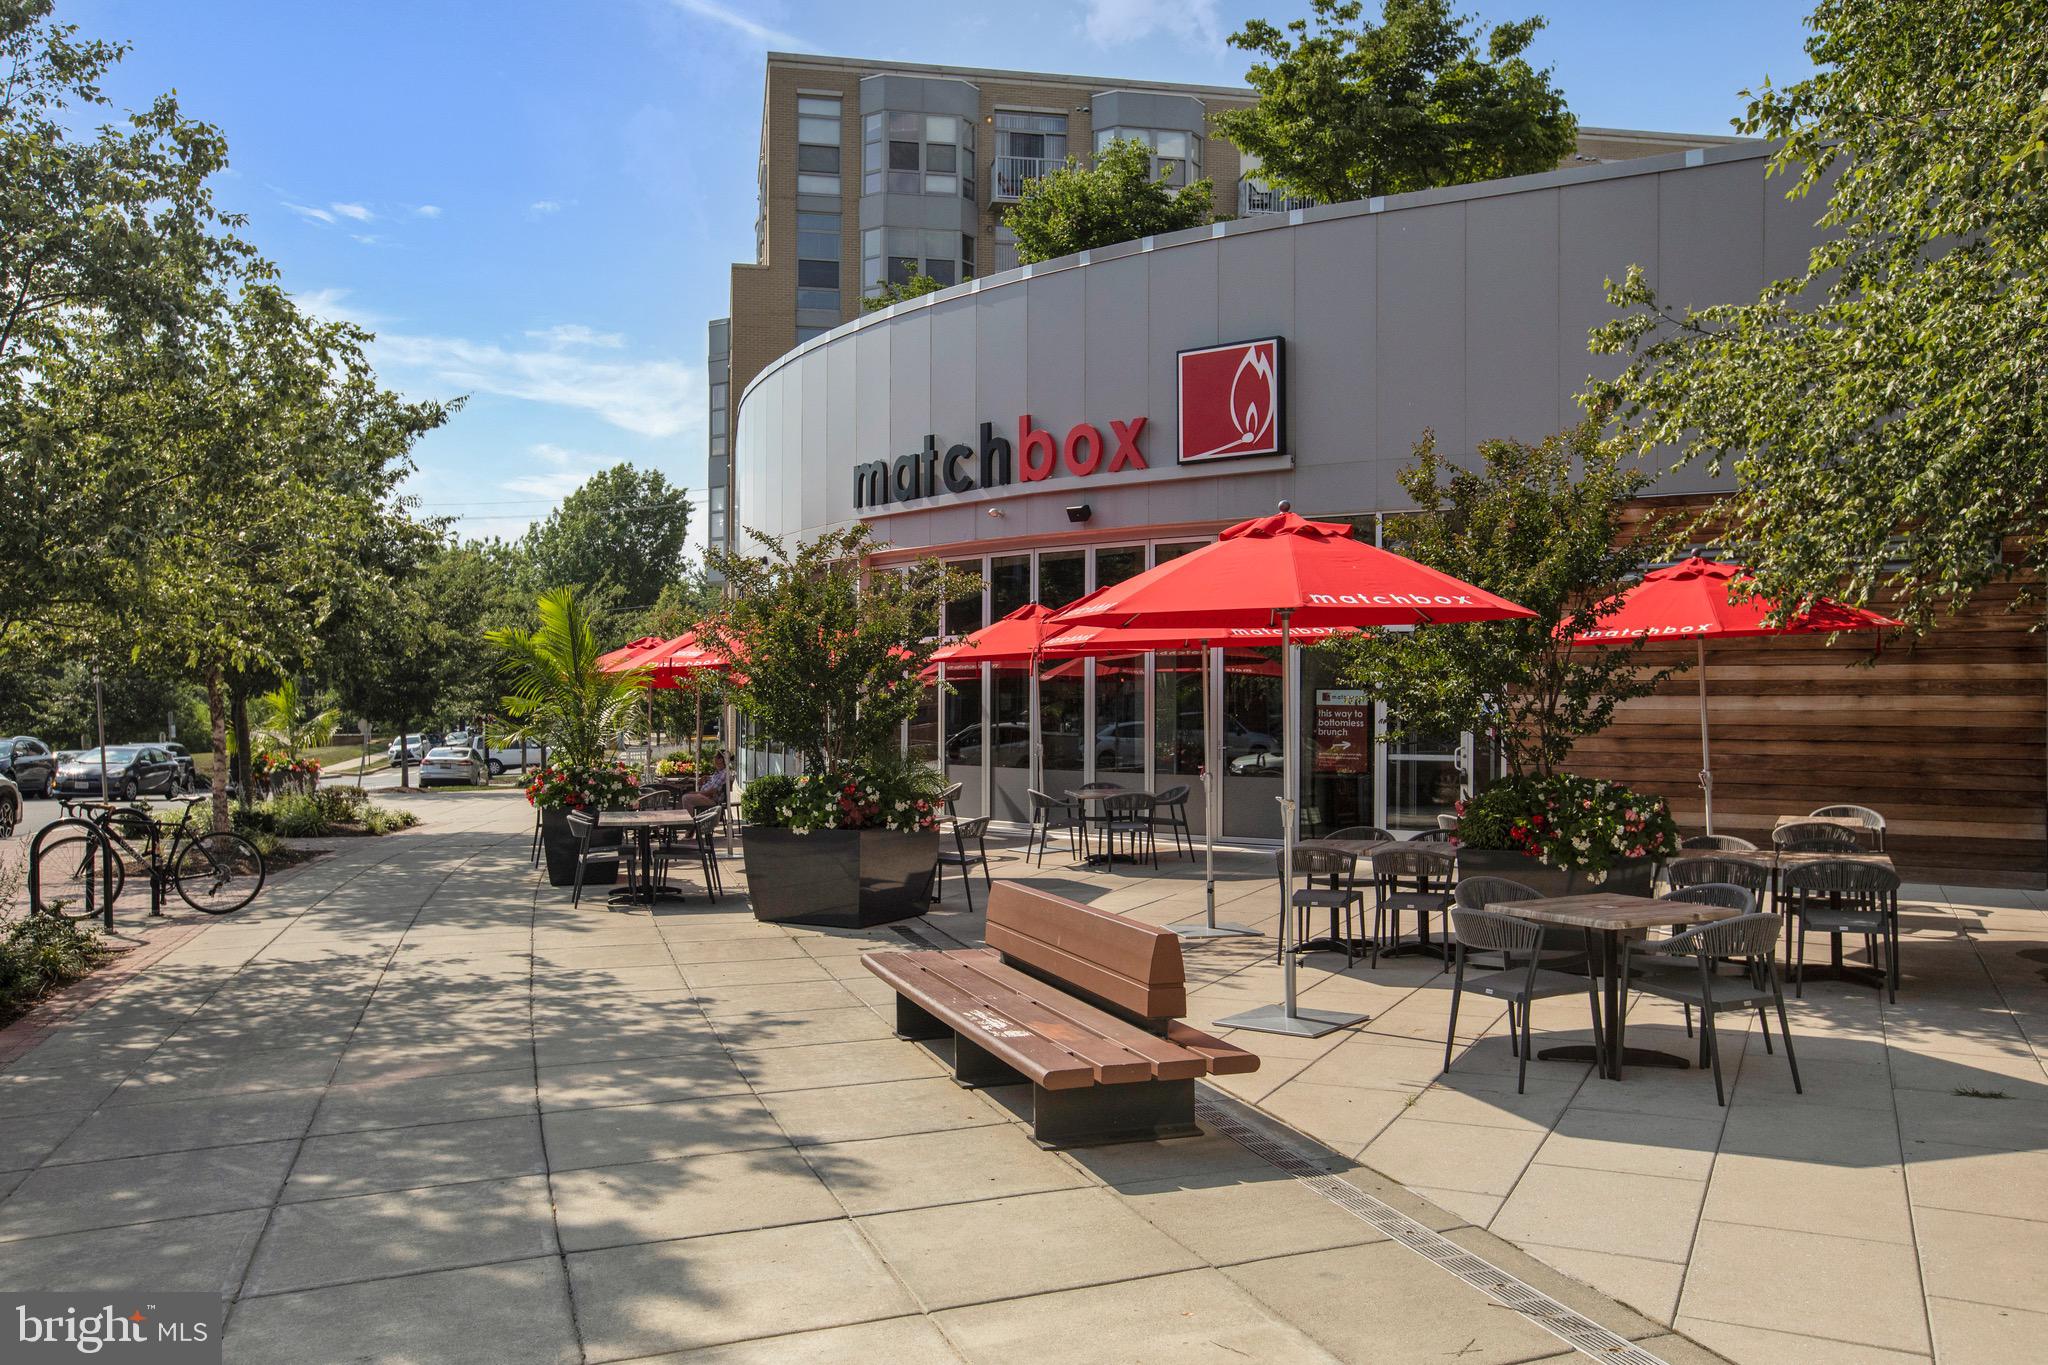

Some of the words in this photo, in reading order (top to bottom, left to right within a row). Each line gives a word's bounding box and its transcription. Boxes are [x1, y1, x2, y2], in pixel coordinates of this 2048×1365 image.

[853, 415, 1149, 509] matchbox
[1309, 593, 1473, 605] matchbox
[1318, 709, 1333, 718] this
[1334, 711, 1352, 719] way
[1354, 709, 1363, 718] to
[1318, 718, 1364, 728] bottomless
[1317, 728, 1348, 736] brunch
